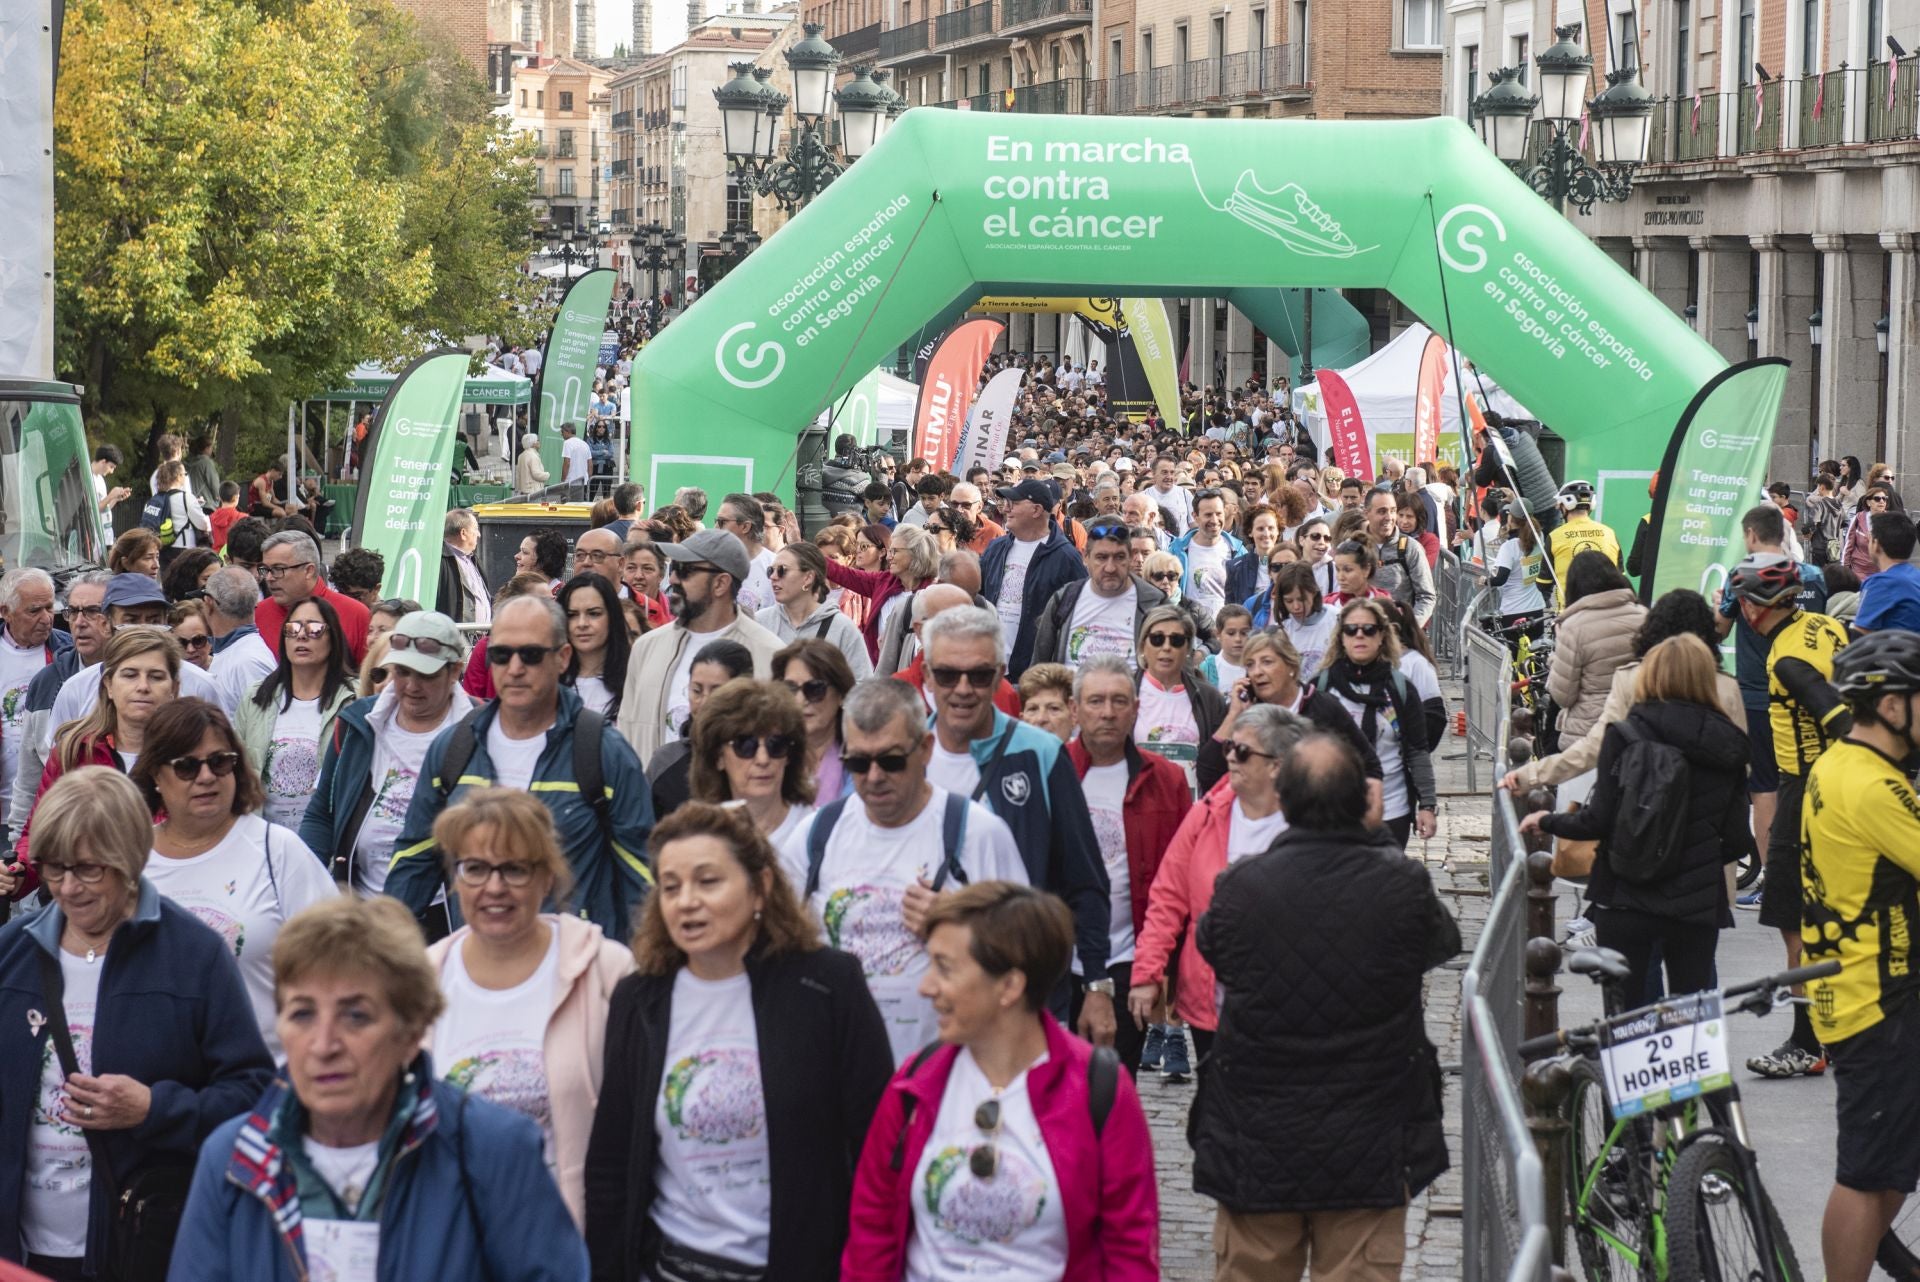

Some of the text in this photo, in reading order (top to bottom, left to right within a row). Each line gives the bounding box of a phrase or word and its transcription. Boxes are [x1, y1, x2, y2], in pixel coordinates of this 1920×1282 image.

[987, 136, 1190, 163] En marcha
[984, 170, 1110, 200] contra
[983, 207, 1164, 239] el cáncer
[1028, 243, 1064, 251] ESPAÑOLA
[768, 194, 911, 317] asociación española
[782, 233, 895, 332] contra el cáncer
[796, 274, 882, 347] en Segovia
[1499, 266, 1613, 369] contra el cáncer
[1513, 252, 1654, 382] asociación española
[1483, 281, 1566, 359] en Segovia
[562, 337, 588, 348] un gran
[564, 328, 596, 341] Tenemos
[558, 351, 572, 360] por
[560, 345, 586, 355] camino
[557, 360, 585, 370] delante
[472, 386, 511, 398] CÁNCER
[972, 409, 994, 468] PINAR
[1334, 418, 1343, 450] Nursery
[1341, 407, 1364, 480] EL PINA
[391, 474, 434, 487] un gran
[1692, 469, 1748, 486] Tenemos
[389, 489, 432, 500] camino
[1689, 487, 1739, 502] un gran
[387, 504, 409, 516] por
[1685, 502, 1734, 517] camino
[1682, 518, 1706, 530] por
[1680, 532, 1729, 547] delante
[1623, 1051, 1710, 1092] HOMBRE
